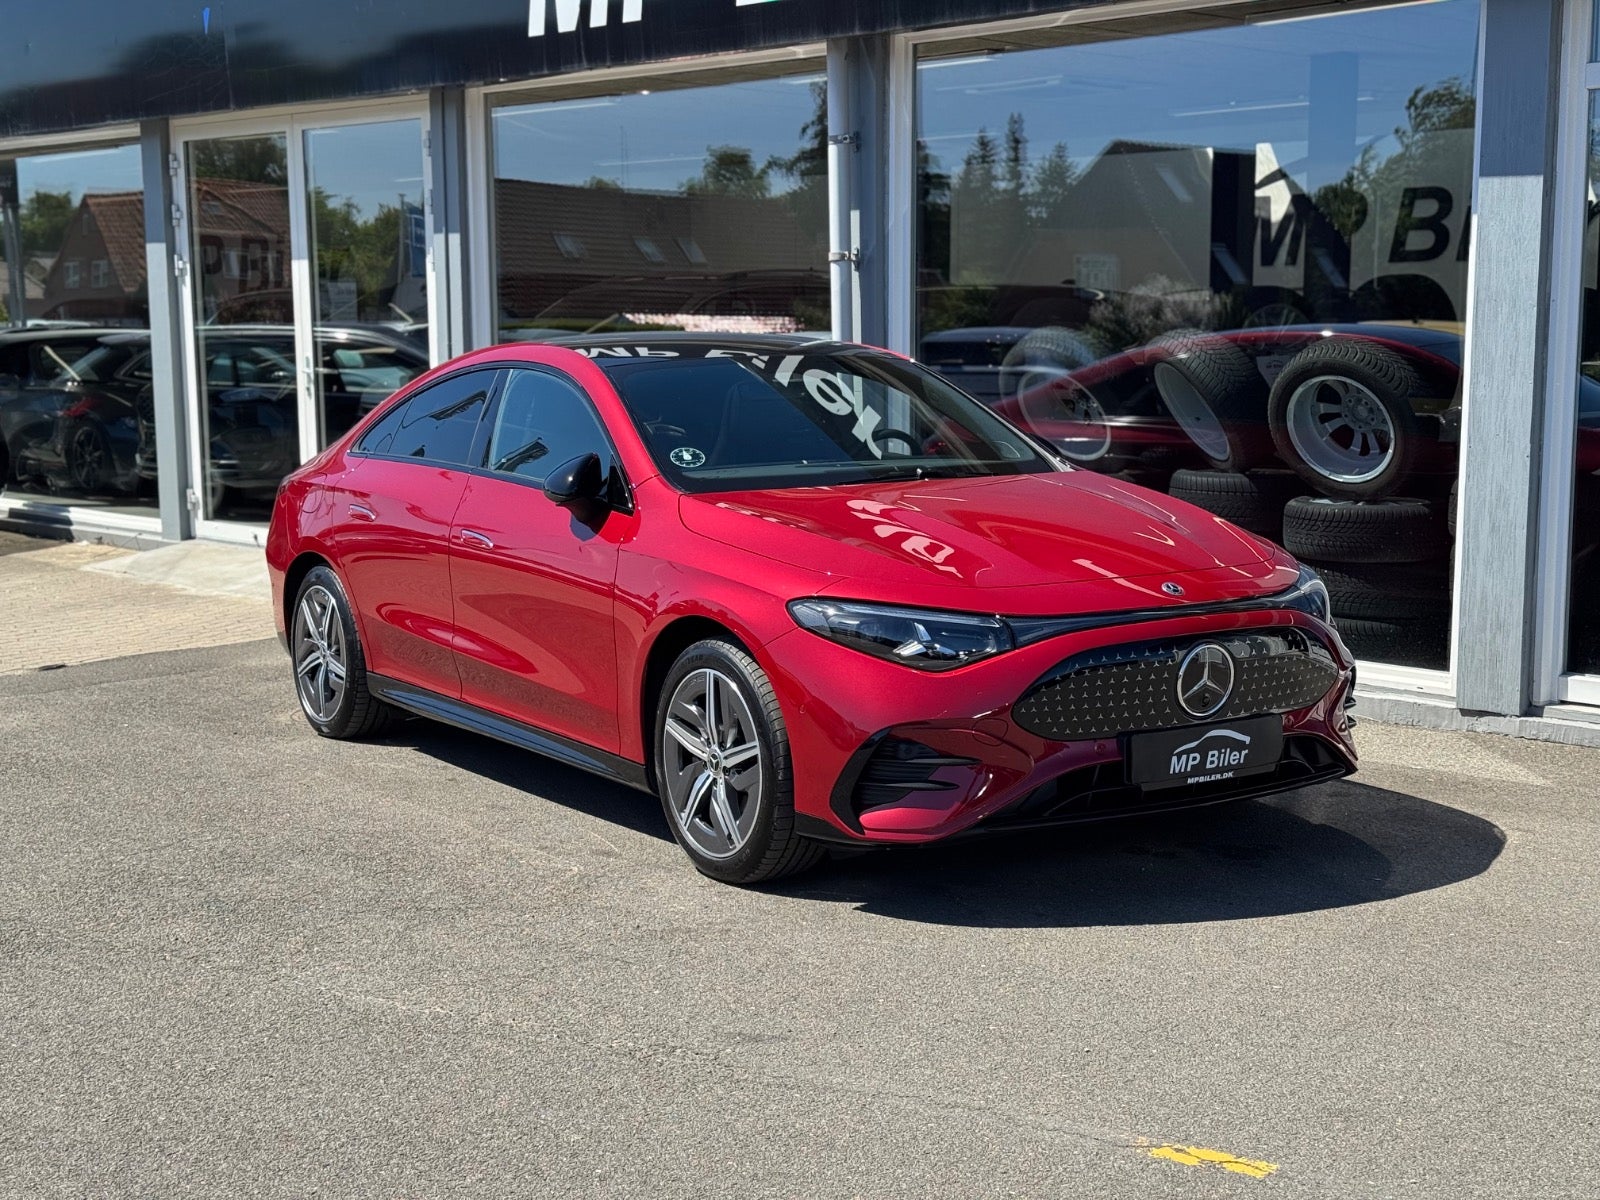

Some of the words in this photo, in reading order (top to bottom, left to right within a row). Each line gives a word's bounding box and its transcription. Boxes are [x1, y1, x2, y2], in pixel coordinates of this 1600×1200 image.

[1170, 753, 1200, 774] MP
[1206, 748, 1248, 769] Biler
[1187, 772, 1234, 784] MPBILER.DK
